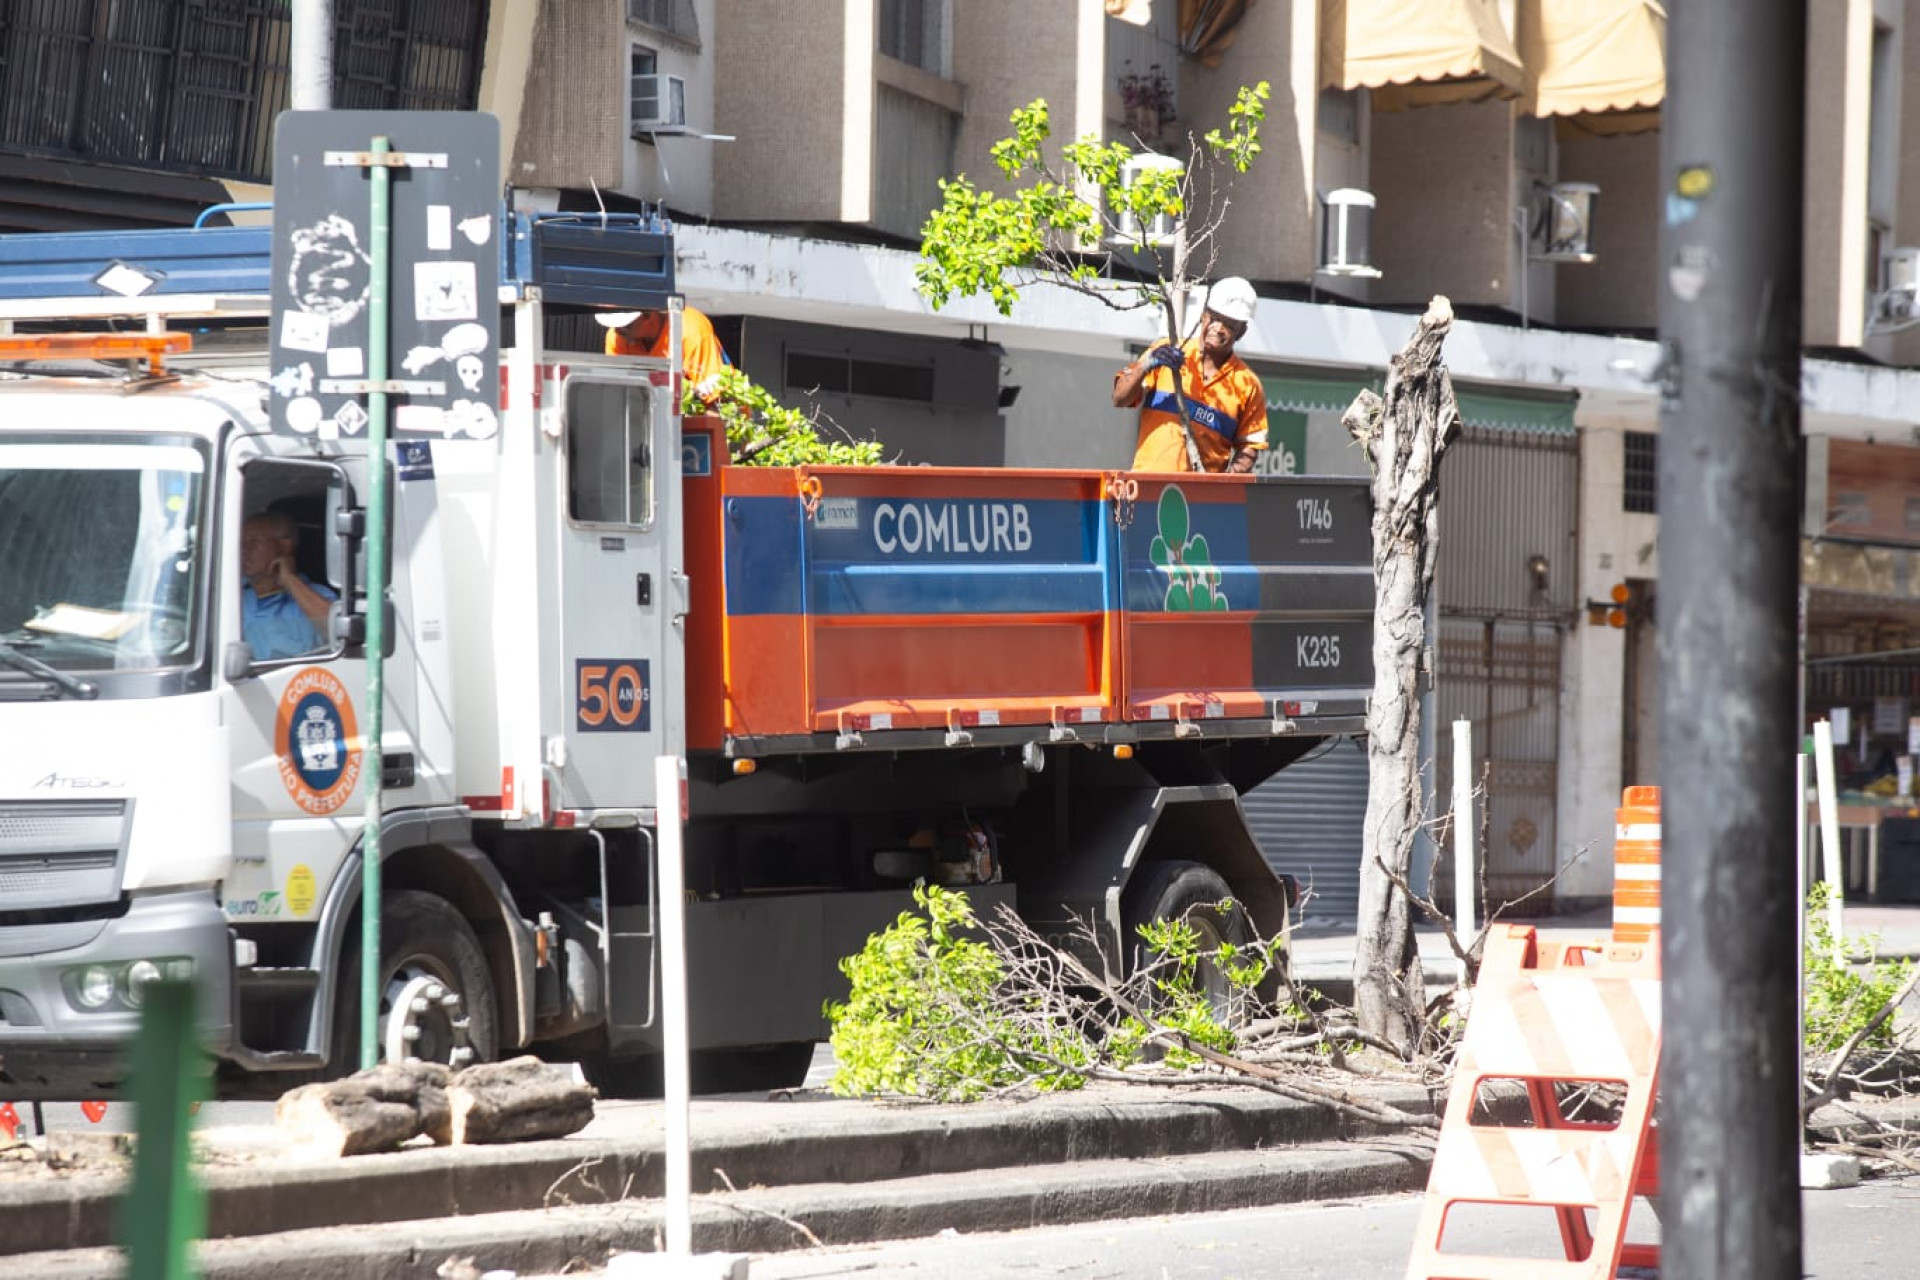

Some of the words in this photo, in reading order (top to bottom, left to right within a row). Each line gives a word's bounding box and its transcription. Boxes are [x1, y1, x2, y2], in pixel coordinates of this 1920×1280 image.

[1195, 407, 1215, 423] RIO
[873, 503, 1032, 553] COMLURB
[1297, 499, 1333, 529] 1746
[1297, 635, 1340, 667] K235
[287, 673, 344, 704] COMLURB
[579, 665, 643, 726] 50
[619, 688, 649, 701] ANOS
[296, 752, 361, 812] PREFEITURA
